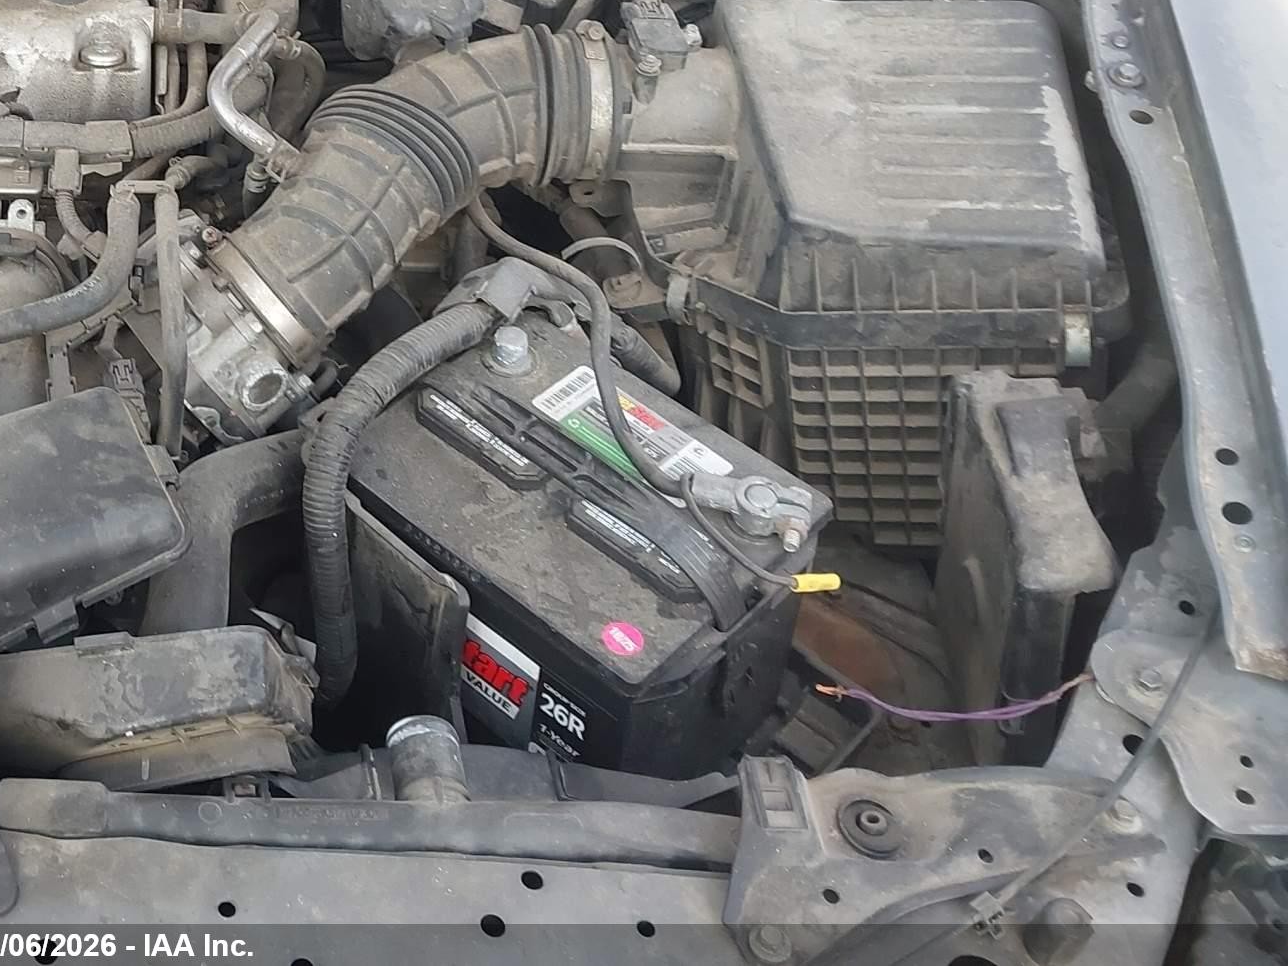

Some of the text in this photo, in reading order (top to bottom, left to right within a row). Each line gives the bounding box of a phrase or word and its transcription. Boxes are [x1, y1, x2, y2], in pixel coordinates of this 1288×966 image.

[462, 638, 529, 707] tart
[465, 670, 513, 714] VALUE
[539, 692, 586, 741] 26R
[540, 723, 581, 756] 1-Year
